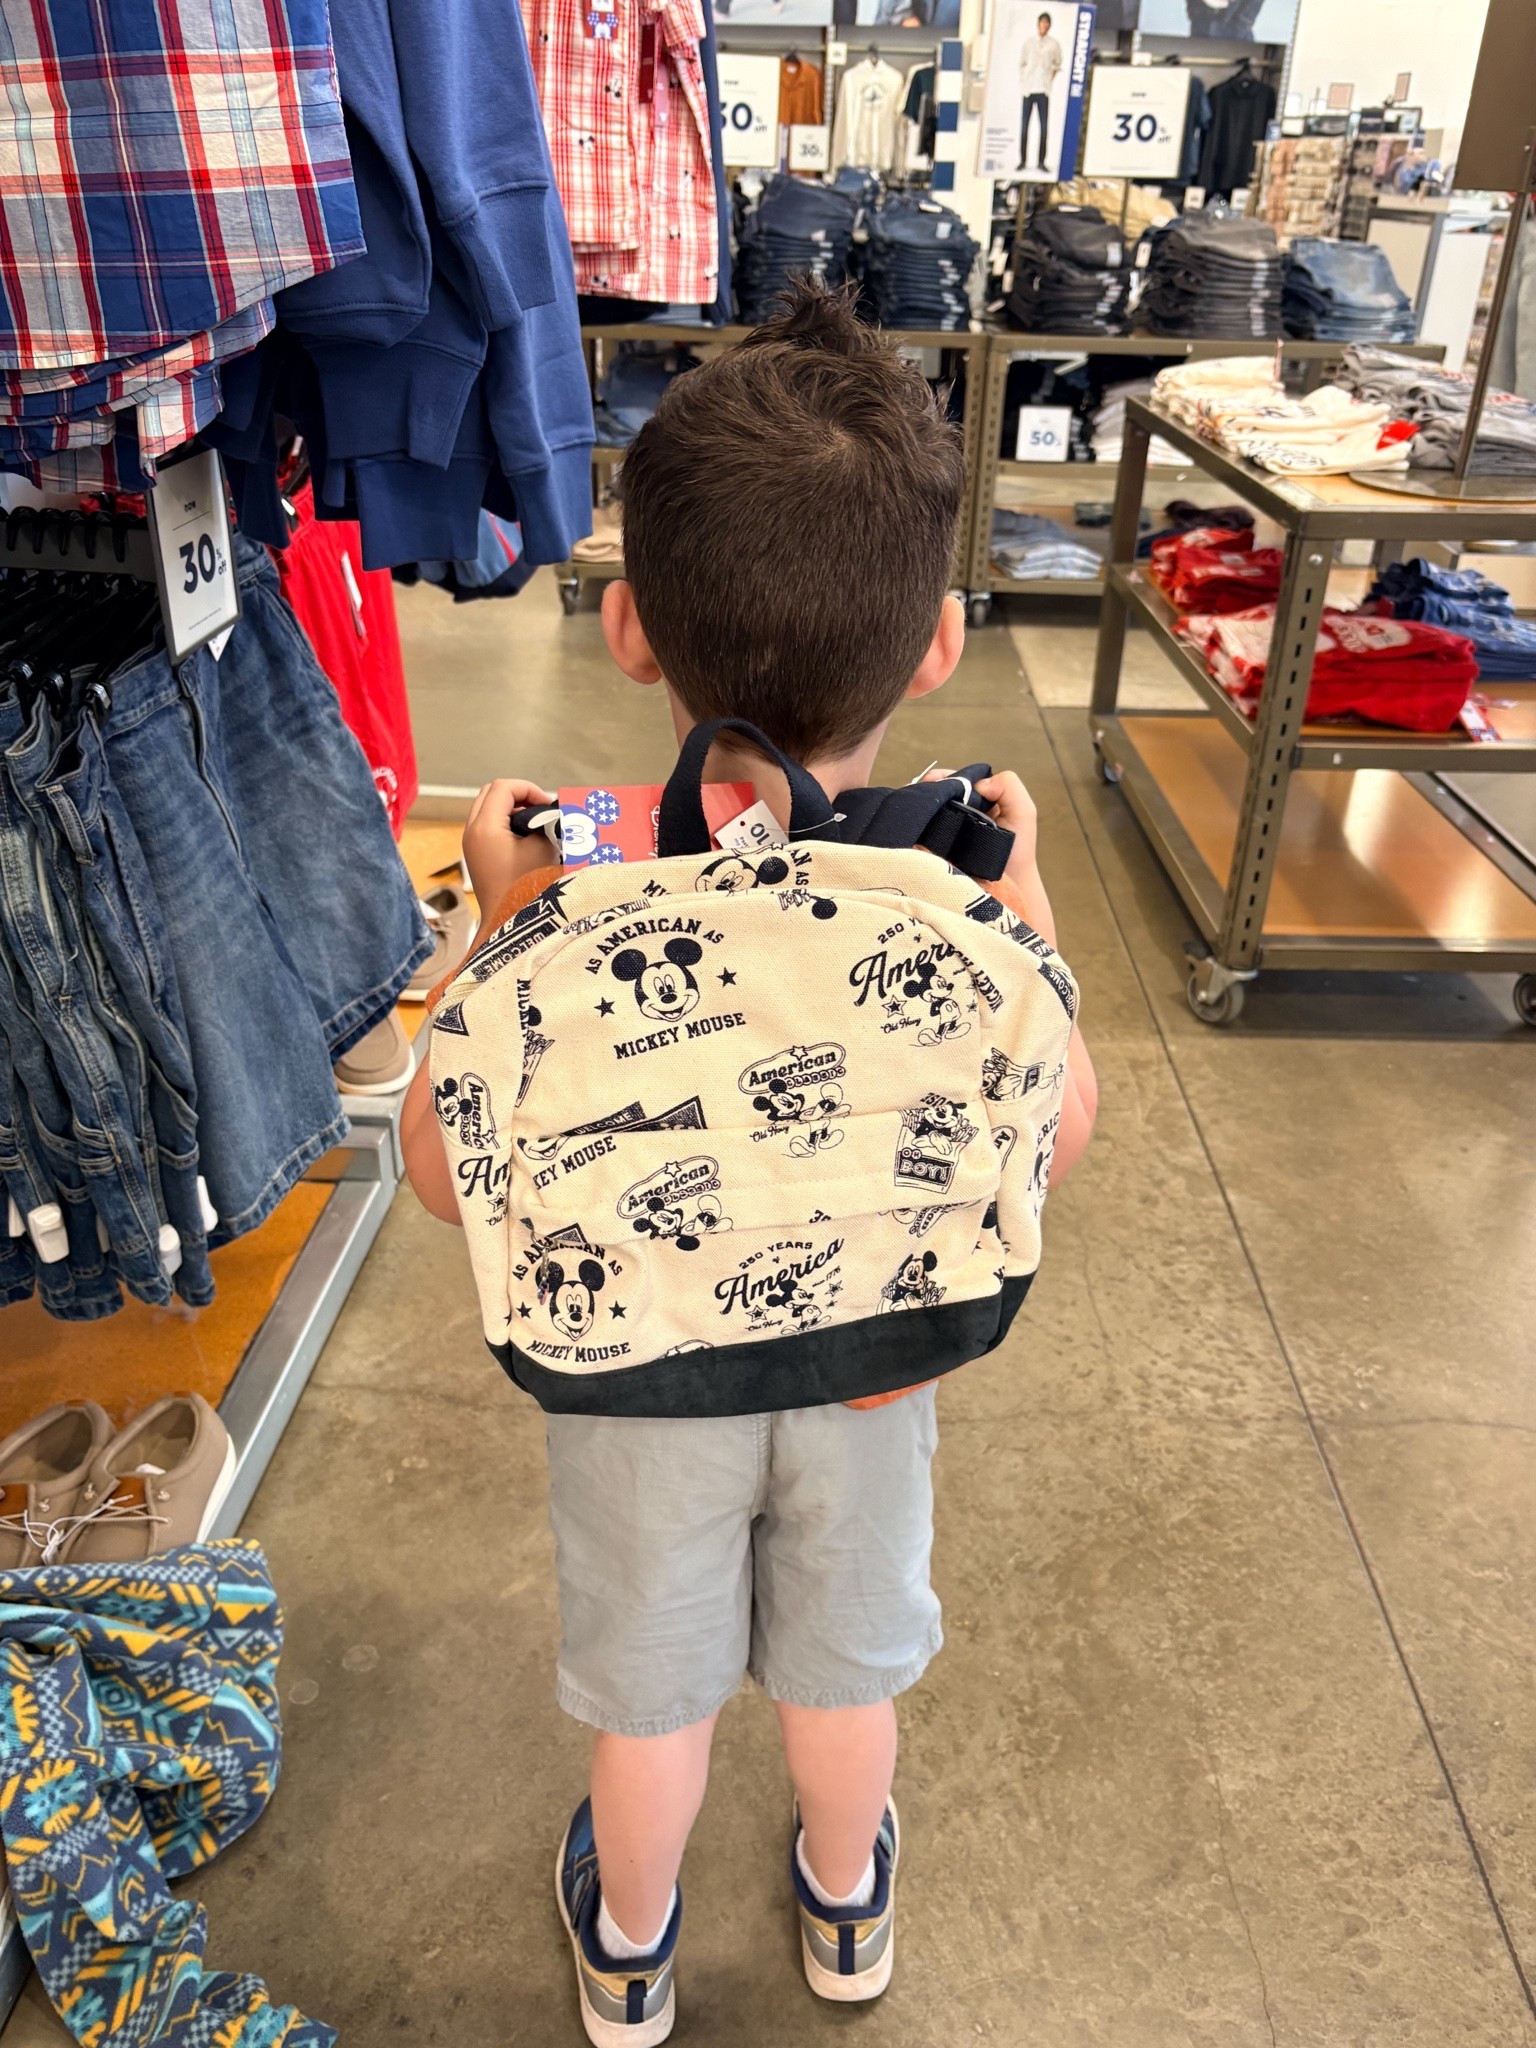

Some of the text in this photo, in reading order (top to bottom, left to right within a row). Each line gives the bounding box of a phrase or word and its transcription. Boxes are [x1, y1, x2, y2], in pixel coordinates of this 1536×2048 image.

[1113, 113, 1157, 142] 30
[1030, 431, 1055, 446] 50
[184, 500, 197, 513] now
[218, 560, 227, 575] off
[795, 871, 809, 886] AS
[877, 922, 905, 944] 250
[585, 917, 725, 975] AS AMERICAN AS
[614, 1012, 747, 1060] MICKEY MOUSE
[749, 1051, 837, 1087] American
[786, 1066, 846, 1089] CLASSIC
[574, 1111, 633, 1135] WELCOME
[561, 1135, 617, 1174] MOUSE
[900, 1159, 949, 1182] BOY!
[627, 1164, 710, 1213] American
[738, 1251, 764, 1270] 250
[767, 1241, 814, 1253] YEARS
[512, 1264, 529, 1281] AS
[608, 1260, 623, 1276] AS
[714, 1238, 845, 1315] America
[526, 1340, 632, 1363] MICKEY MOUSE
